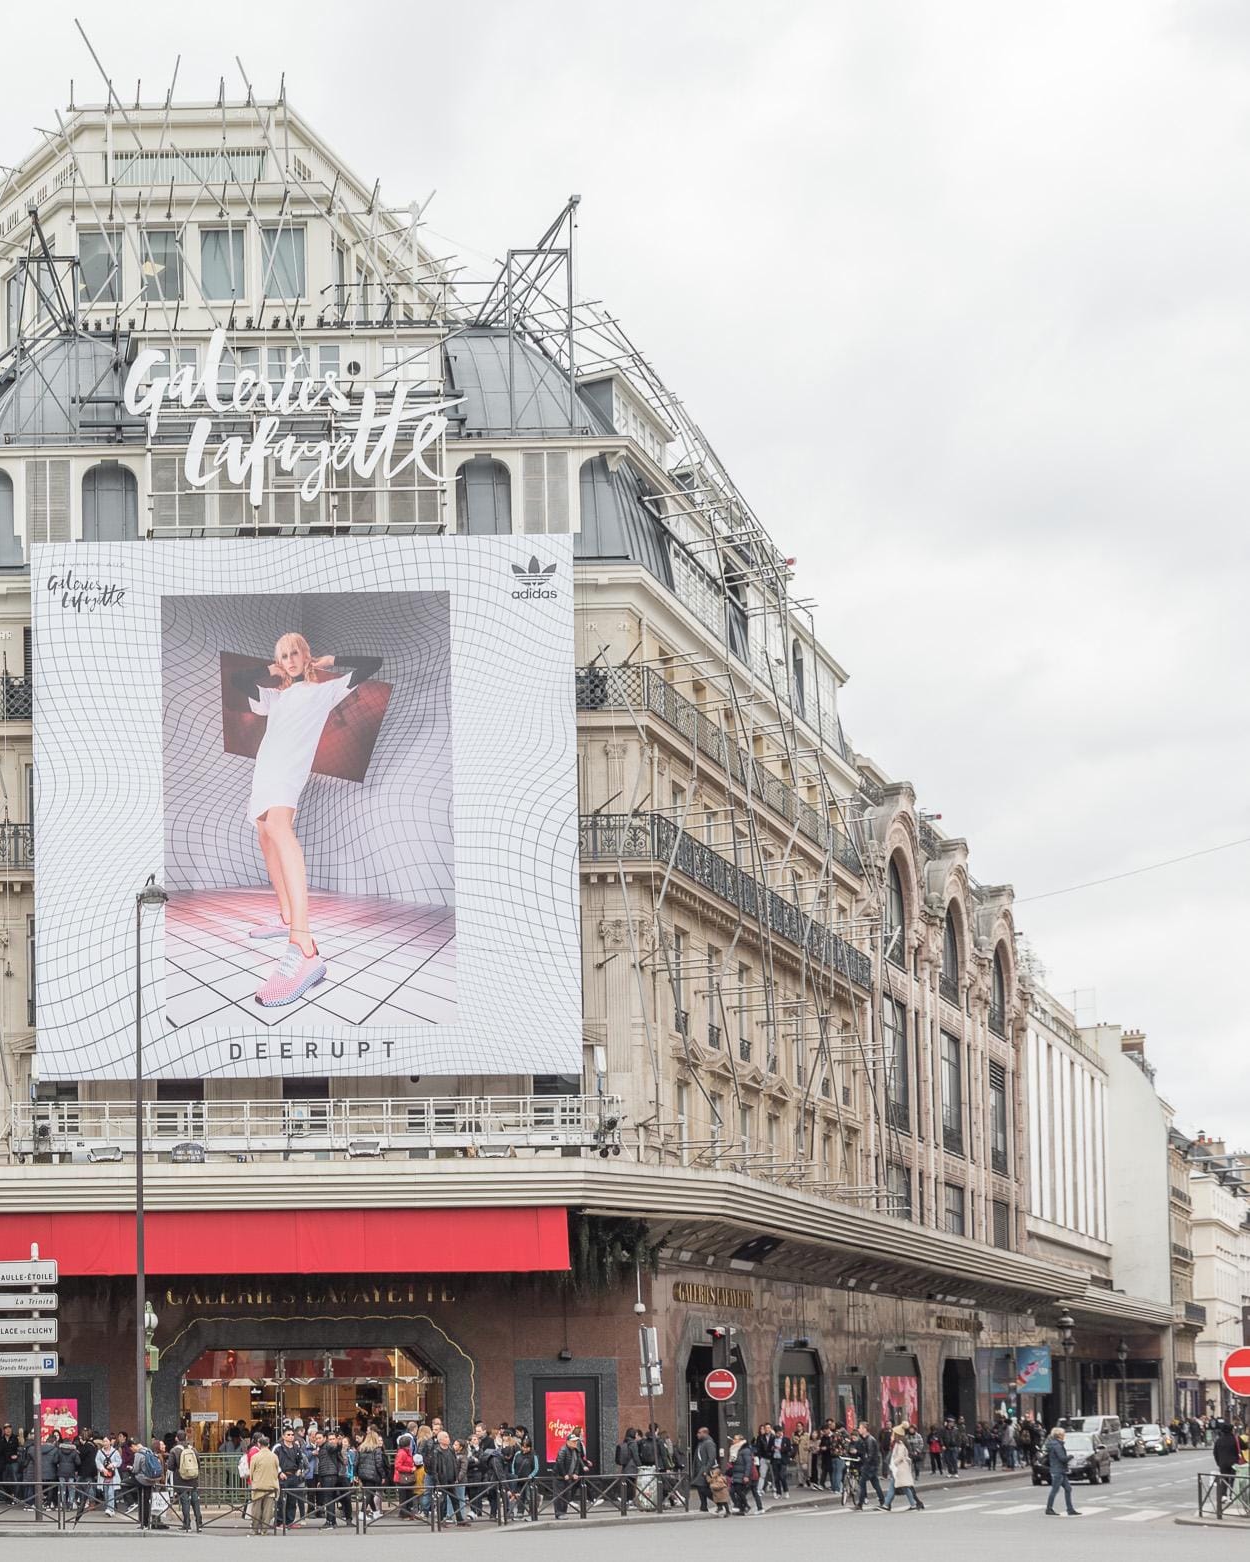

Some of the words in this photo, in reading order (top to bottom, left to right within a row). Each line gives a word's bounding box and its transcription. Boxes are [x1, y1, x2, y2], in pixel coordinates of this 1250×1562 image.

[124, 328, 351, 437] Galeries
[184, 382, 468, 506] Lafayette
[47, 570, 102, 595] Galeries
[511, 587, 558, 600] adidas
[229, 1041, 395, 1060] DEERUPT
[679, 1283, 716, 1306] GALERIES
